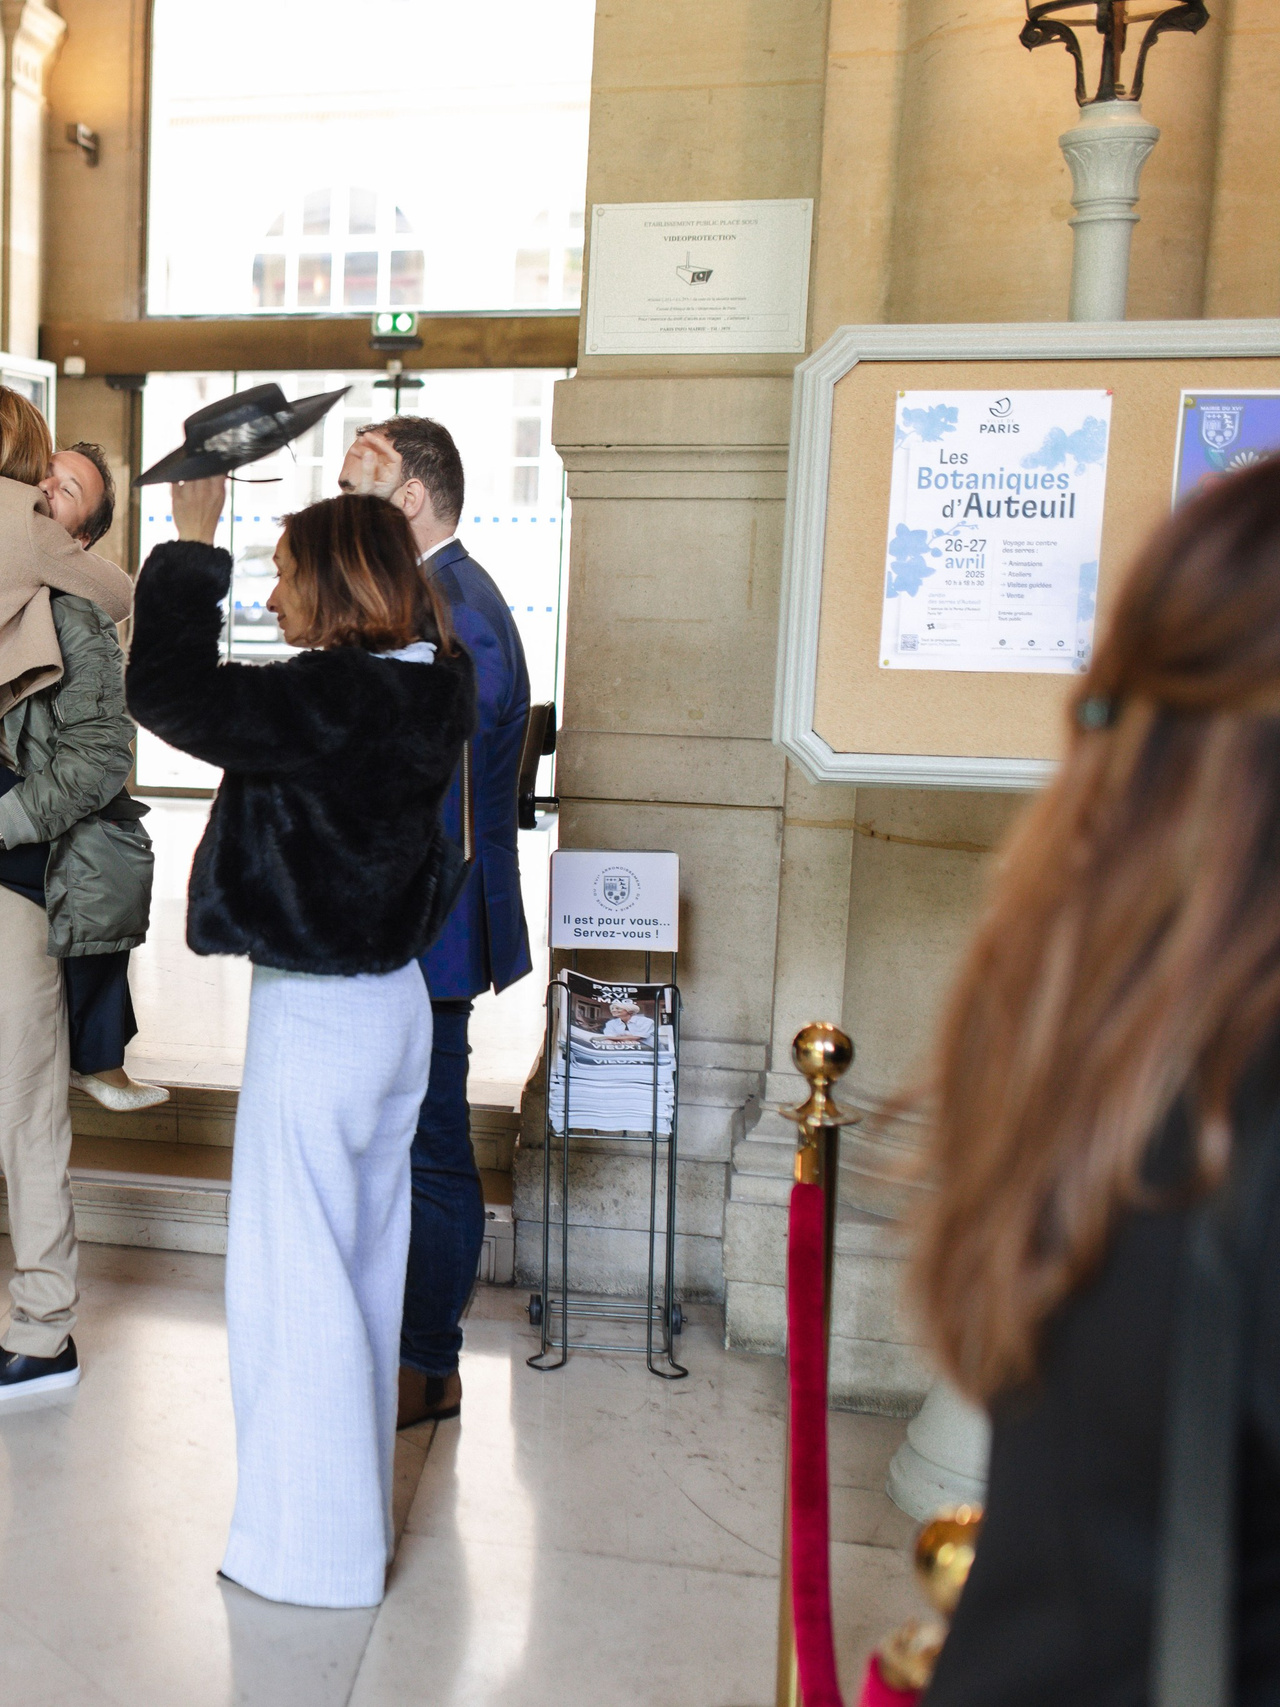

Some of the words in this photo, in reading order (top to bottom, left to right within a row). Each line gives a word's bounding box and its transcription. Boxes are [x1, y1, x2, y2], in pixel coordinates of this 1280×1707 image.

[663, 234, 737, 242] VIDEOPROTECTION
[979, 423, 1020, 434] PARIS
[939, 449, 969, 465] Les
[917, 466, 1070, 495] Botaniques
[941, 492, 1076, 519] d'Auteuil
[945, 539, 987, 552] 26-27
[945, 553, 985, 569] avril
[965, 570, 985, 578] 2025
[563, 914, 571, 924] Il
[574, 915, 594, 925] est
[597, 917, 626, 927] pour
[629, 918, 671, 926] vous...
[573, 927, 652, 939] Servez-vous
[592, 983, 639, 993] PARIS
[602, 991, 629, 999] XVI
[590, 1042, 635, 1050] VIEUX
